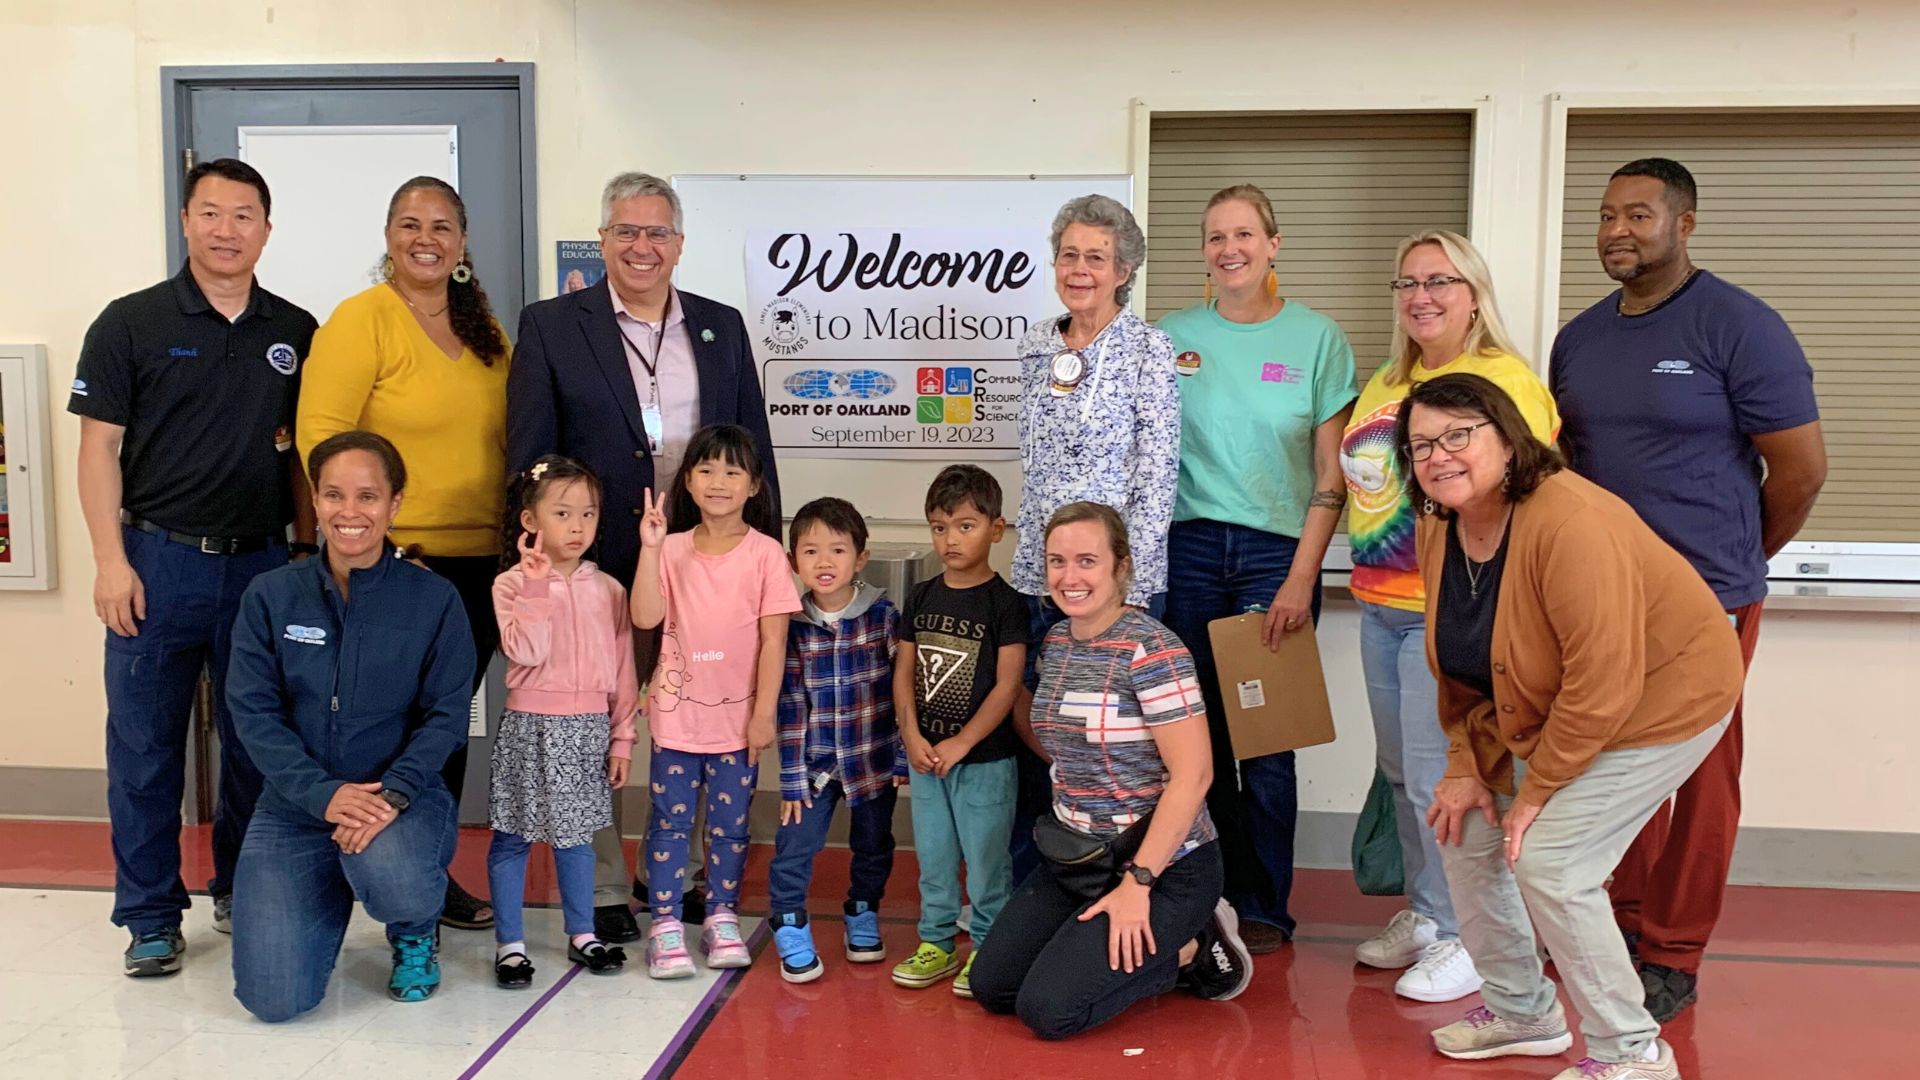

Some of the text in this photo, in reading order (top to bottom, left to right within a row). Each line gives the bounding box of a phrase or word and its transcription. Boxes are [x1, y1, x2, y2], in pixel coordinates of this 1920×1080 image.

[562, 242, 602, 250] PHYSICAL
[562, 250, 603, 259] EDUCATIO
[767, 233, 1037, 297] Welcome
[813, 304, 1028, 341] to Madison
[762, 336, 809, 355] MUSTANGS
[973, 368, 1022, 384] COMMUN
[974, 387, 1022, 403] RESOURC
[769, 404, 911, 416] PORT OF OAKLAND
[811, 425, 917, 447] September
[946, 426, 995, 443] 2023
[913, 614, 986, 639] GUESS
[692, 650, 725, 662] Hello
[1211, 941, 1233, 974] HOKA
